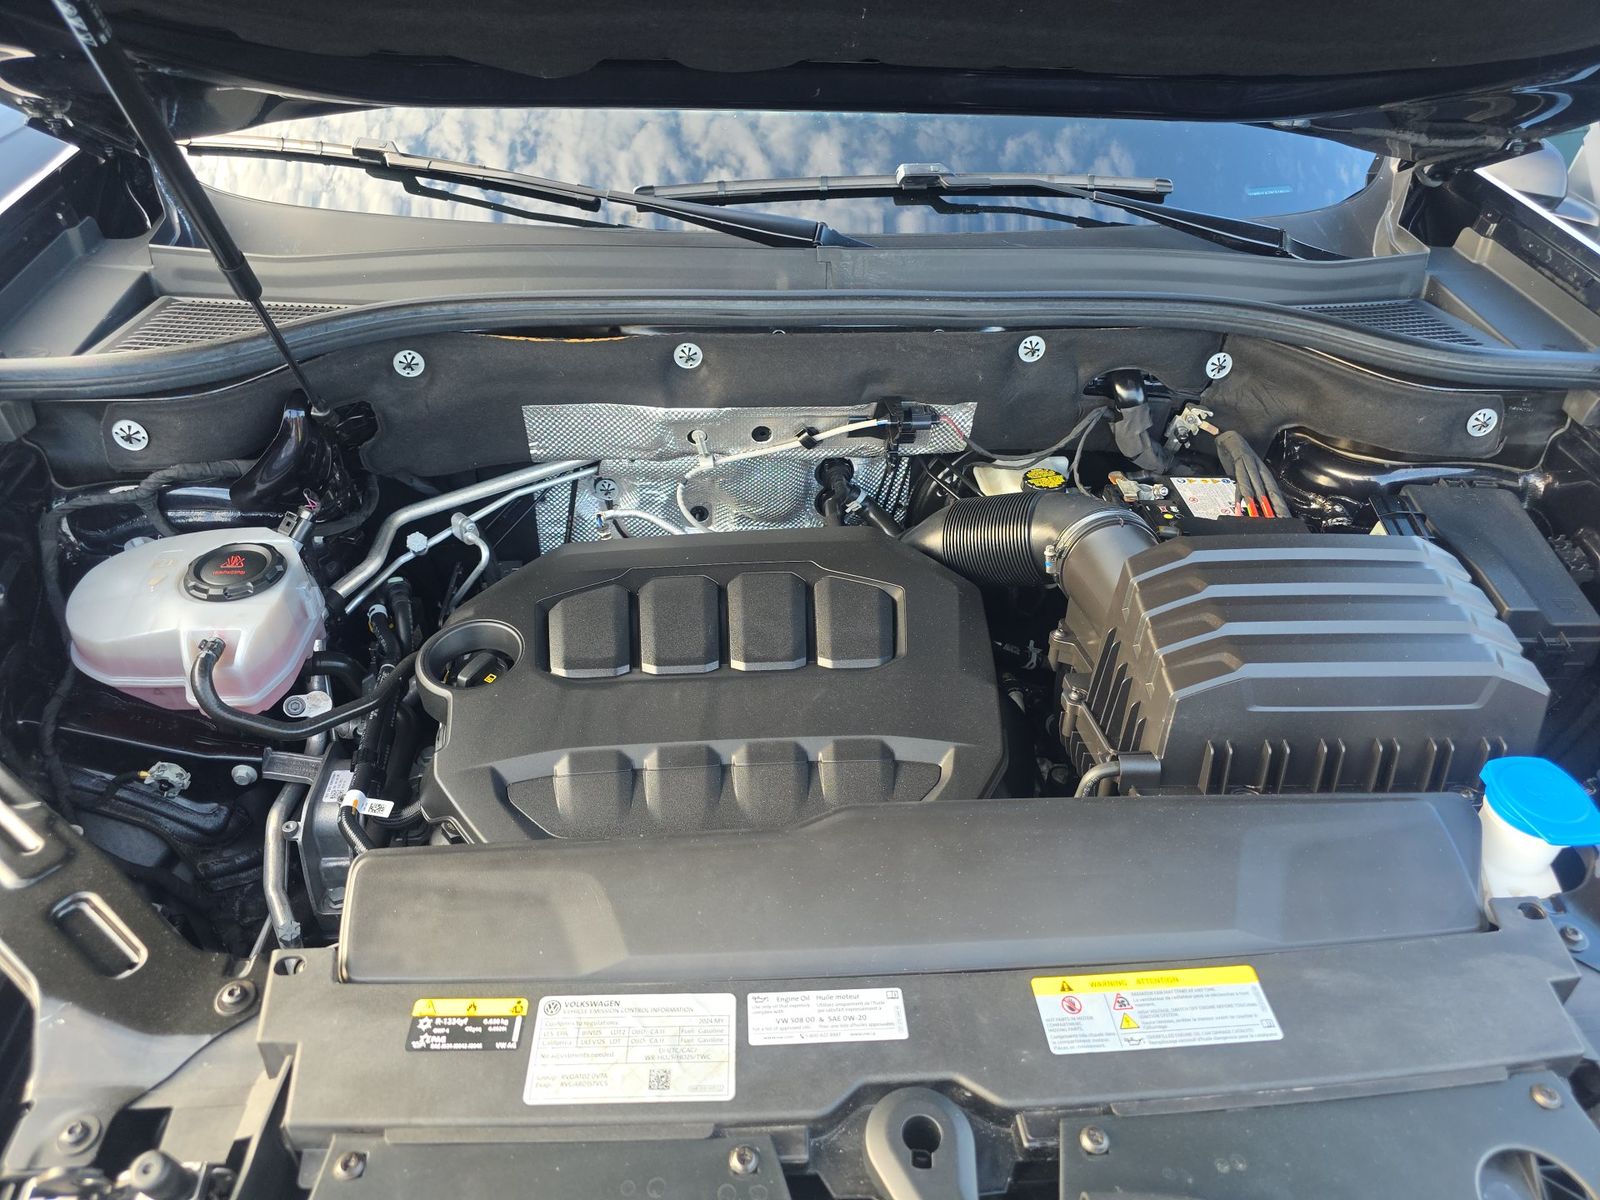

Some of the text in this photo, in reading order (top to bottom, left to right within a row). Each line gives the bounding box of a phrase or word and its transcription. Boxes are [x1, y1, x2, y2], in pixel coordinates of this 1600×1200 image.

[1089, 976, 1179, 988] WARNING ATTENTION
[564, 1000, 621, 1008] VOLKSWAGEN
[776, 996, 800, 1004] Engine
